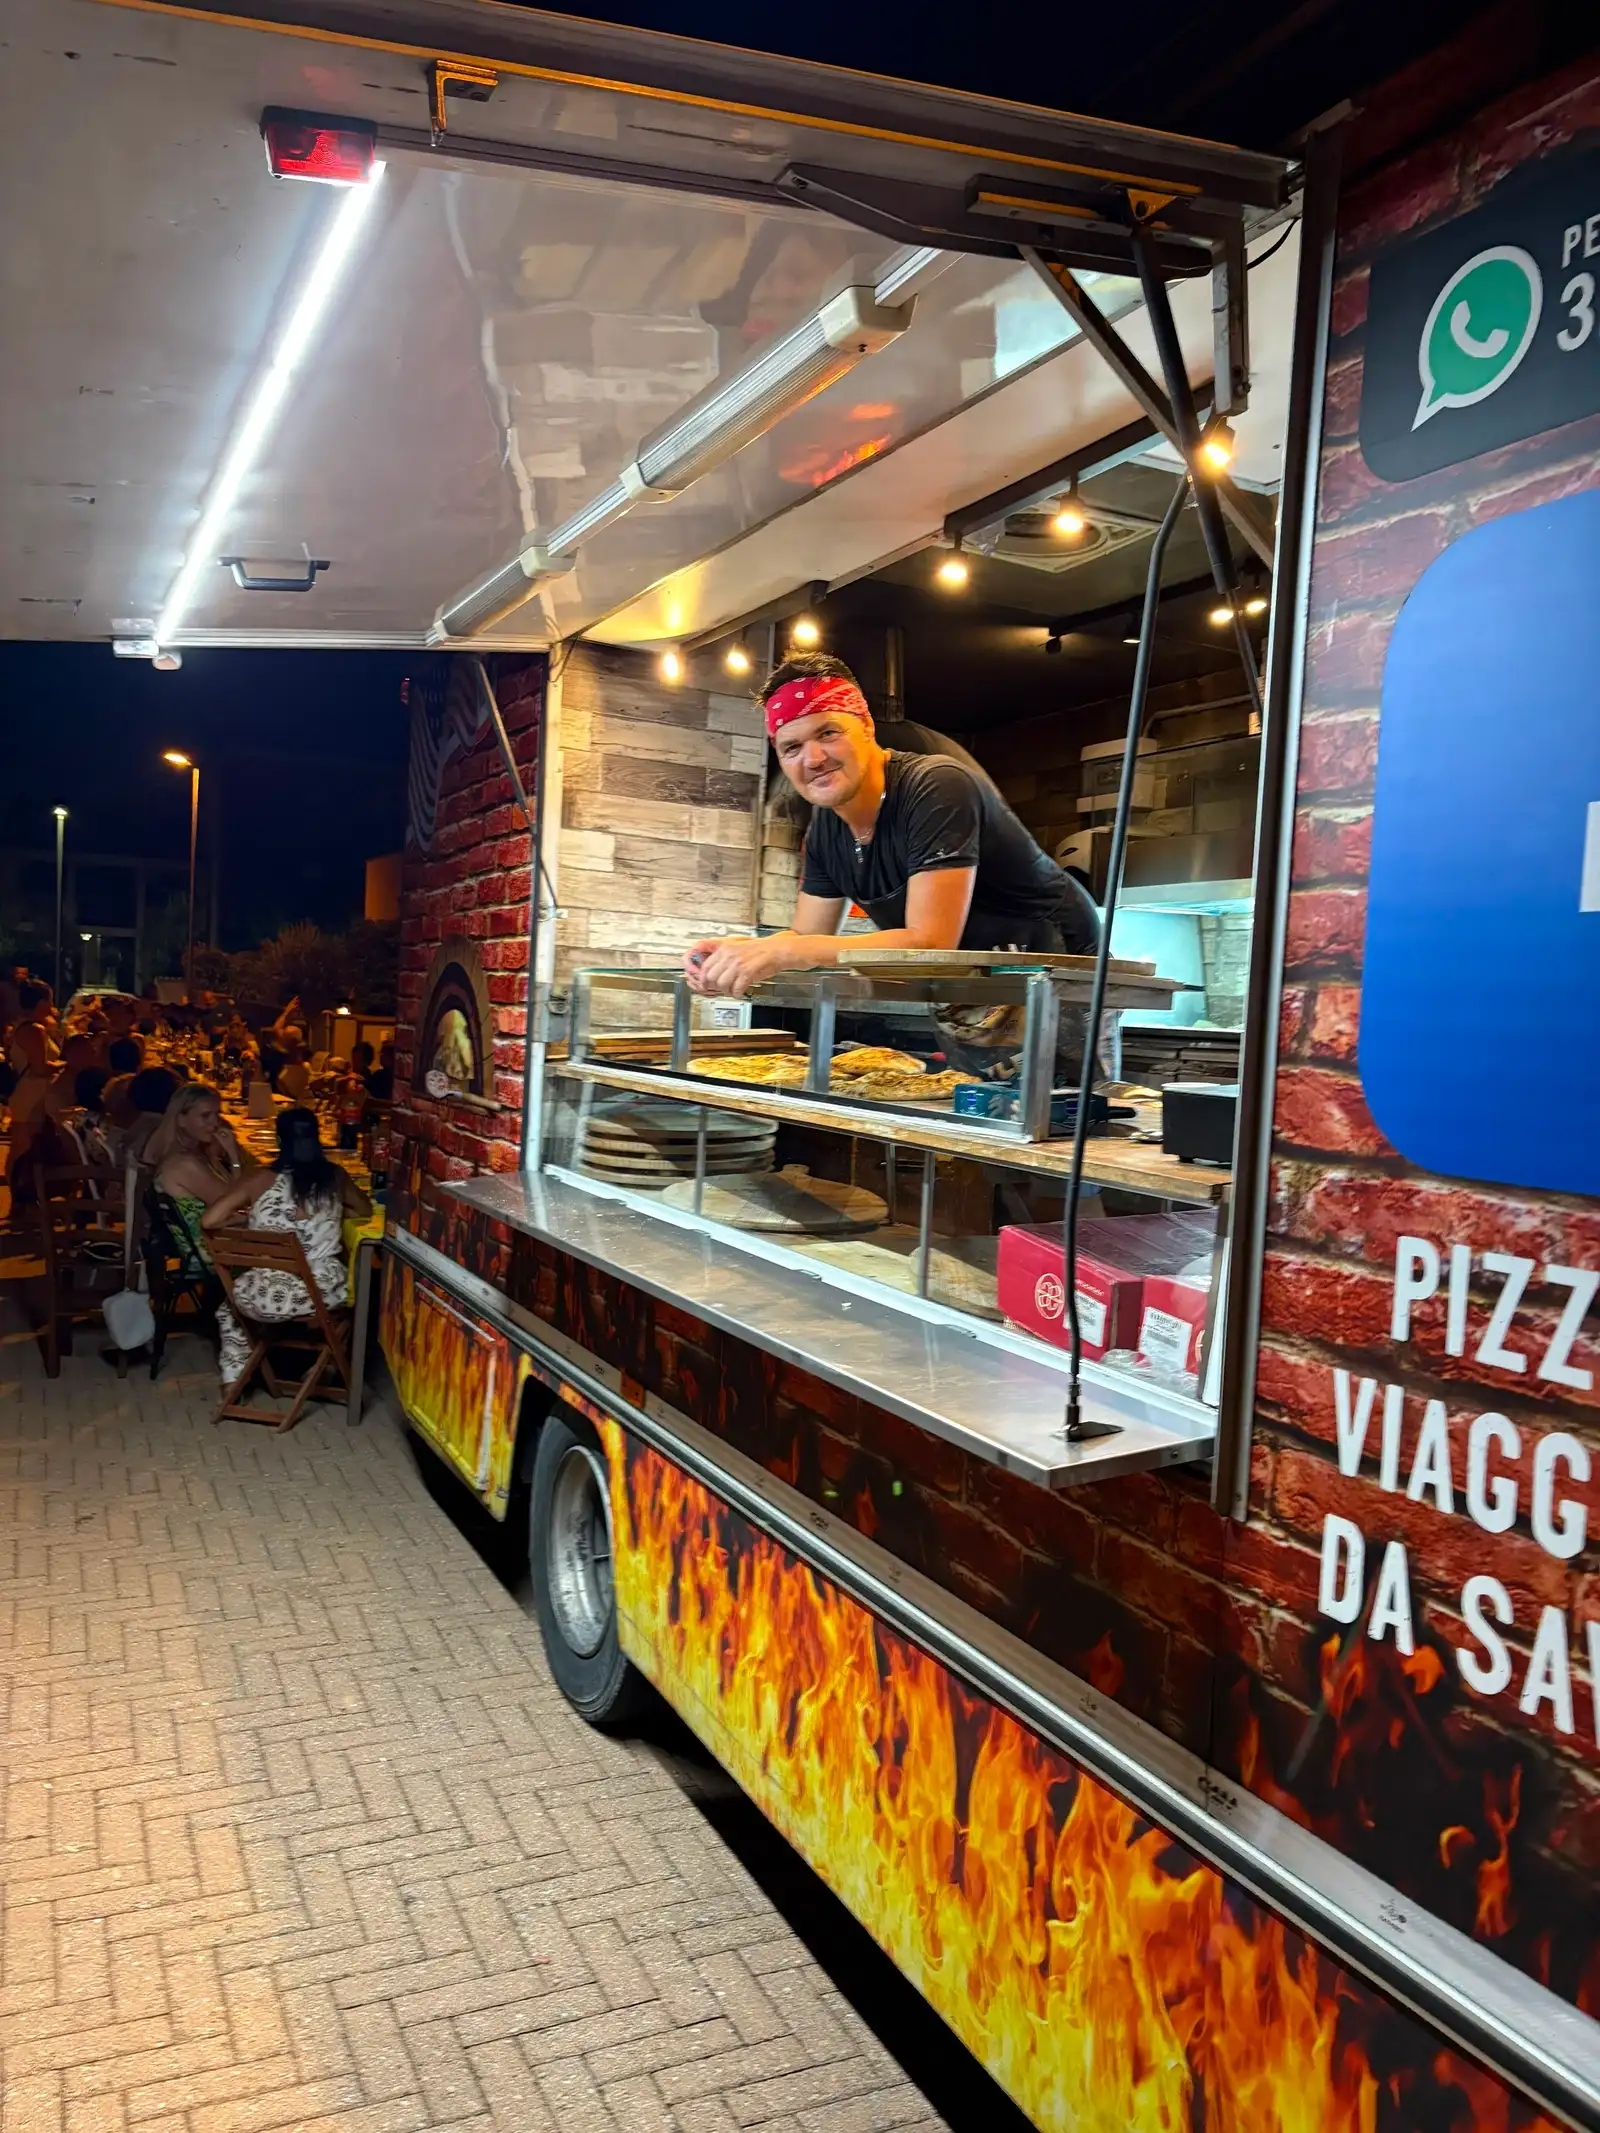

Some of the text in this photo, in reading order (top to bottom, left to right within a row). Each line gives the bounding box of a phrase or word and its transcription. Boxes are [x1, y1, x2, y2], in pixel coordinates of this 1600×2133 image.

[1390, 1235, 1600, 1391] PIZZ
[1334, 1367, 1591, 1560] VIAGG
[1318, 1513, 1414, 1656] DA
